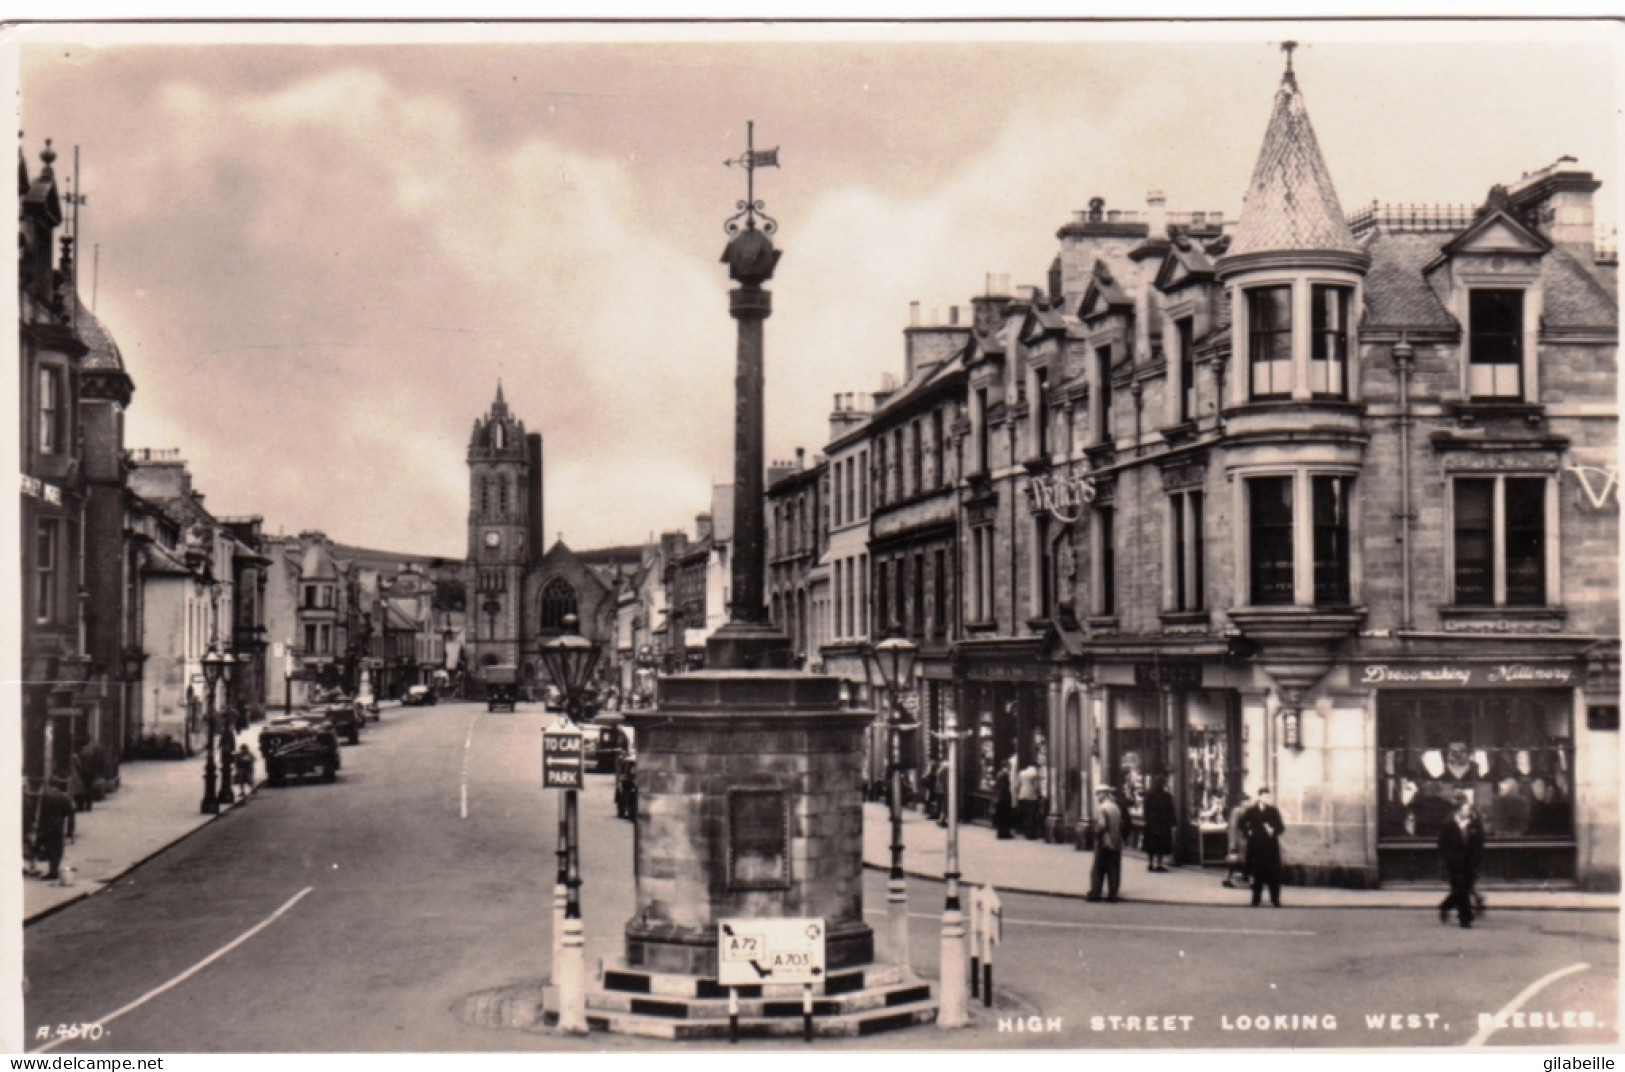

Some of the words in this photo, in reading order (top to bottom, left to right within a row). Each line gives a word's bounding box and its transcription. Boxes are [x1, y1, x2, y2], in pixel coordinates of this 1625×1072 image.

[1361, 664, 1471, 685] Dressmaking
[545, 737, 558, 751] TO
[560, 737, 580, 751] CAR
[548, 771, 577, 784] PARK
